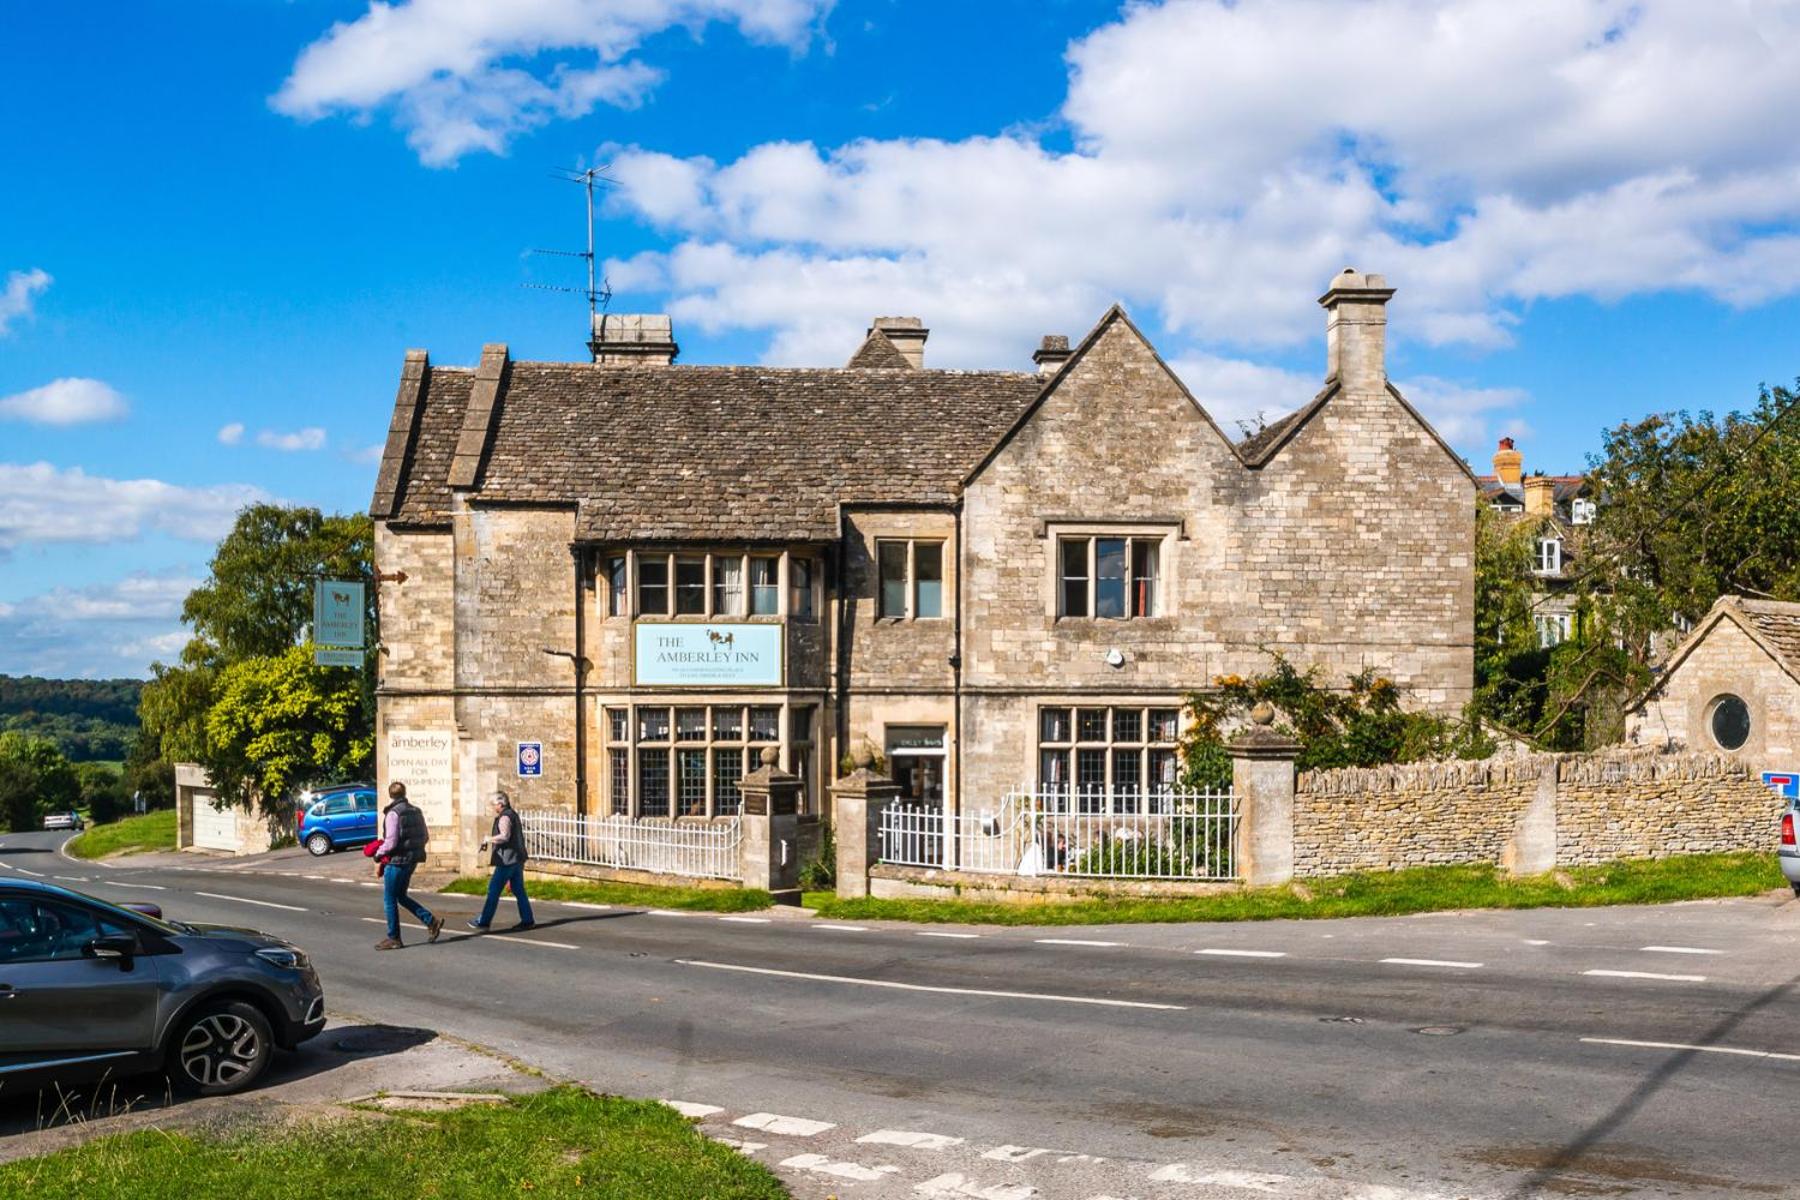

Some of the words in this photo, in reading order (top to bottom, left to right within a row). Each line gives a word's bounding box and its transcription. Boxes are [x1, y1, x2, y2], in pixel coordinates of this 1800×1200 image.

[656, 636, 685, 648] THE
[656, 652, 734, 663] AMBERLEY
[735, 651, 760, 663] INN
[391, 736, 448, 751] amberley
